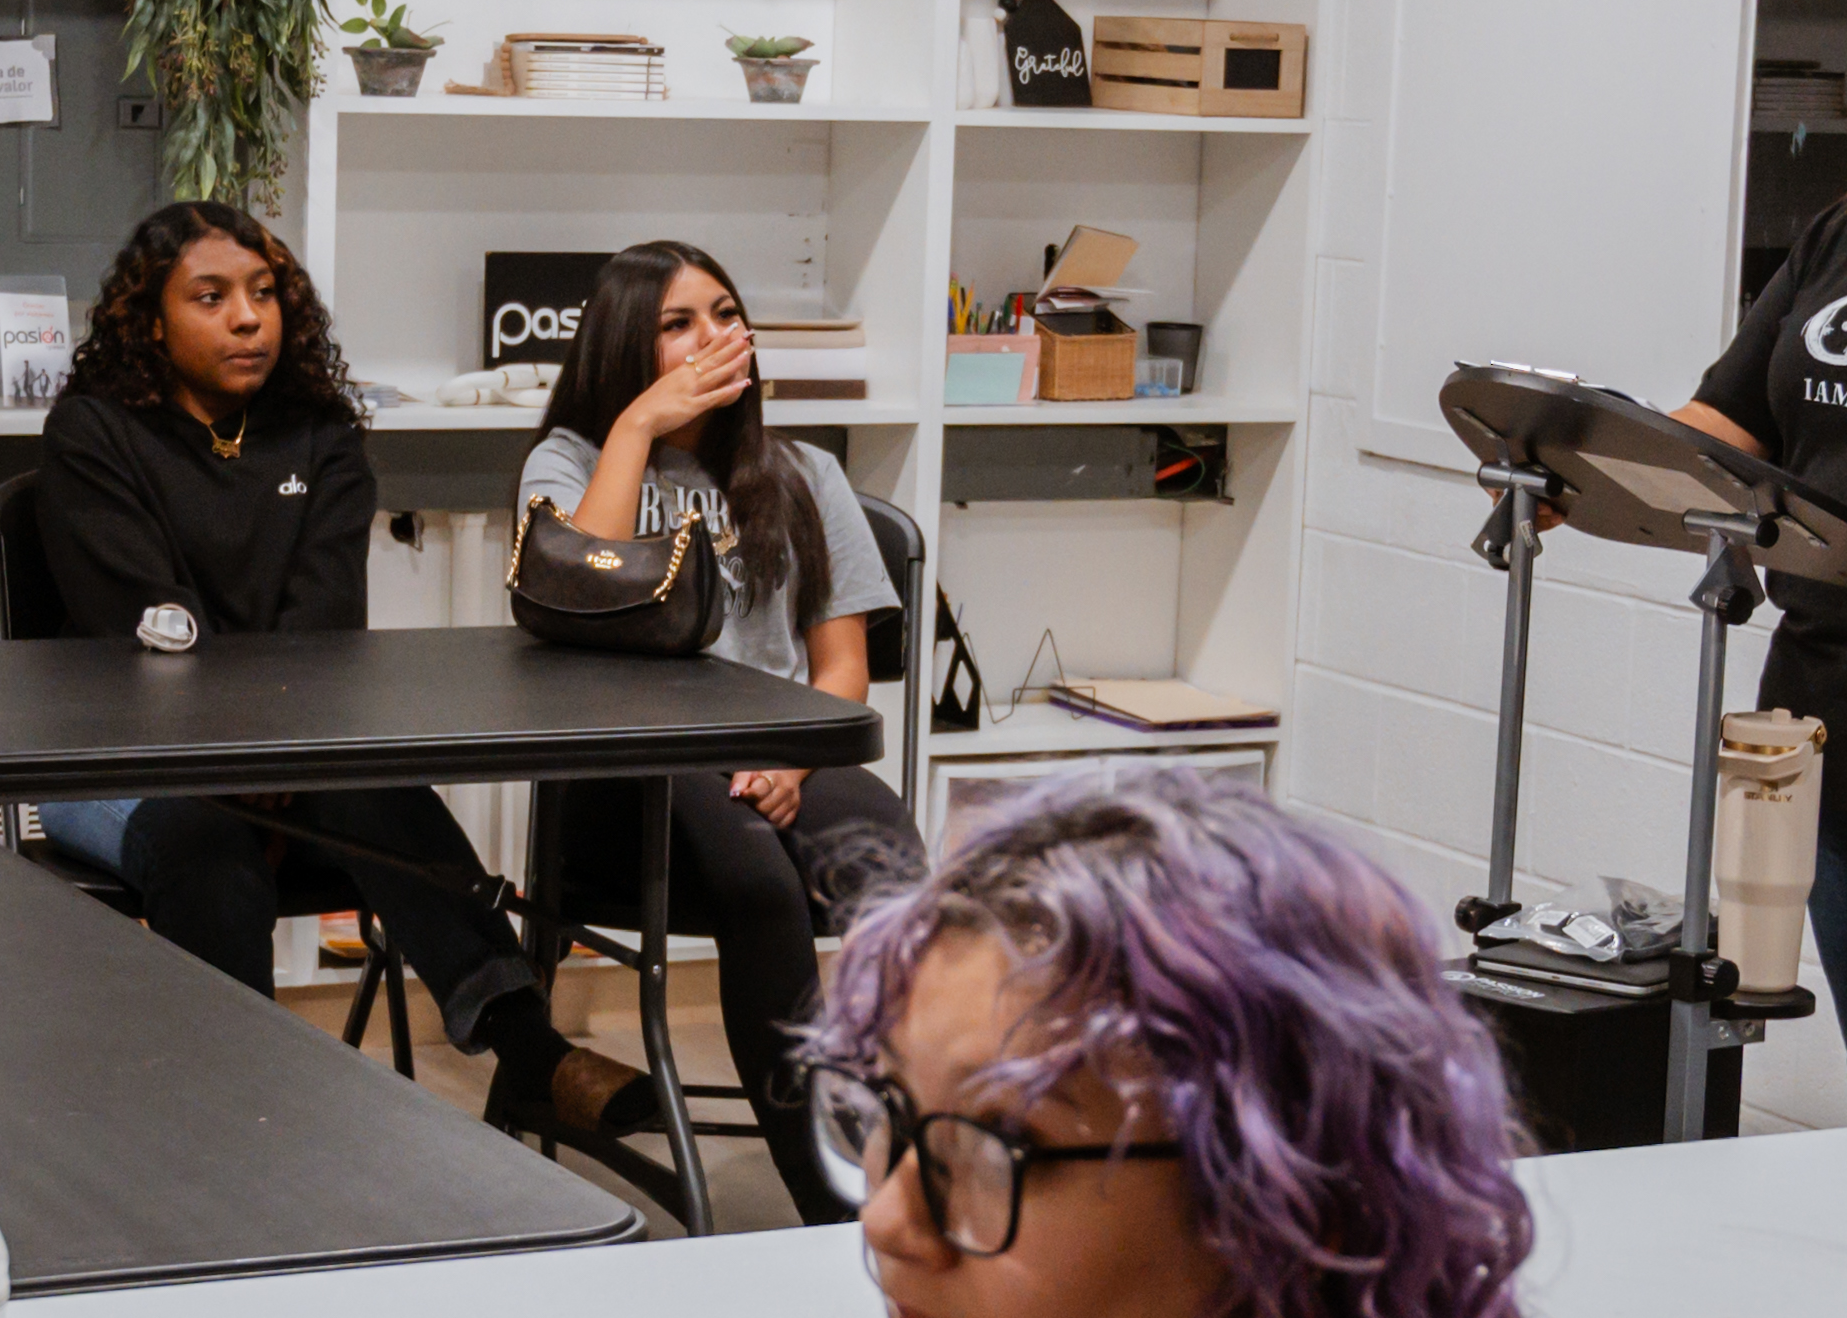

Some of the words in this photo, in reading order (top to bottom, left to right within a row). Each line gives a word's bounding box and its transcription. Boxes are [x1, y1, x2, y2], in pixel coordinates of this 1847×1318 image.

[7, 65, 25, 78] de
[1015, 46, 1084, 84] Grateful
[4, 325, 65, 349] pasión
[492, 300, 587, 358] pas
[1804, 377, 1812, 401] I
[278, 473, 308, 496] alo
[669, 485, 733, 534] JOR
